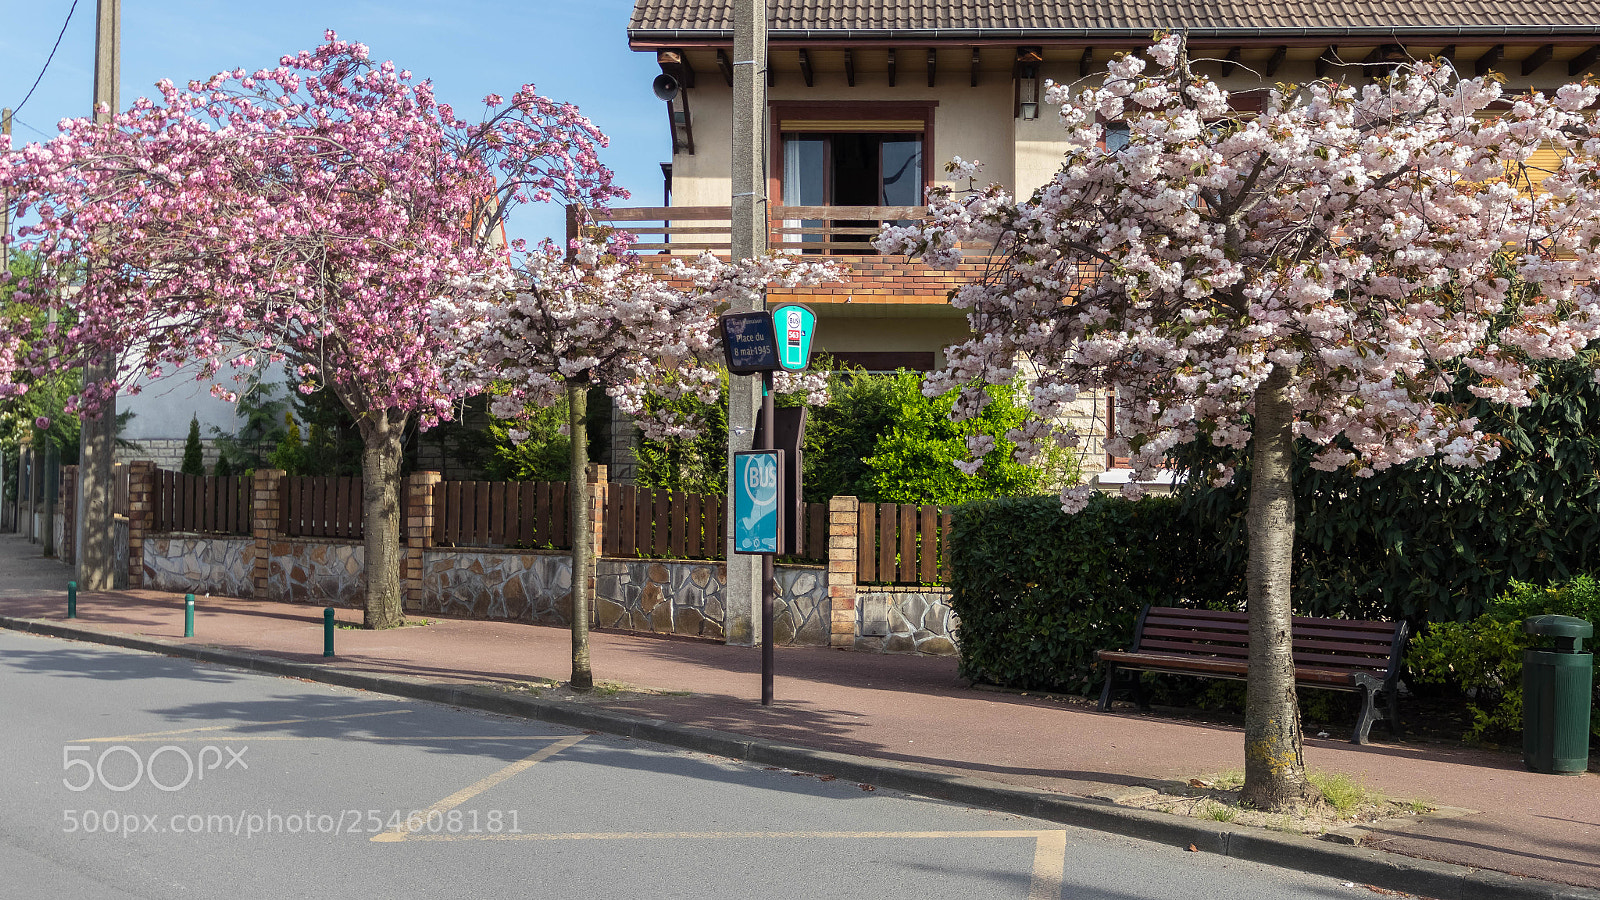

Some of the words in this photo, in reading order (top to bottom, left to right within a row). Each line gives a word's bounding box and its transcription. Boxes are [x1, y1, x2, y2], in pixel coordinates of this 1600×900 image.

[789, 317, 800, 325] BUS
[735, 333, 754, 343] Place
[755, 332, 765, 341] du
[734, 347, 740, 356] 8
[740, 346, 754, 356] mai
[754, 345, 771, 355] 1945
[749, 466, 777, 488] BUS
